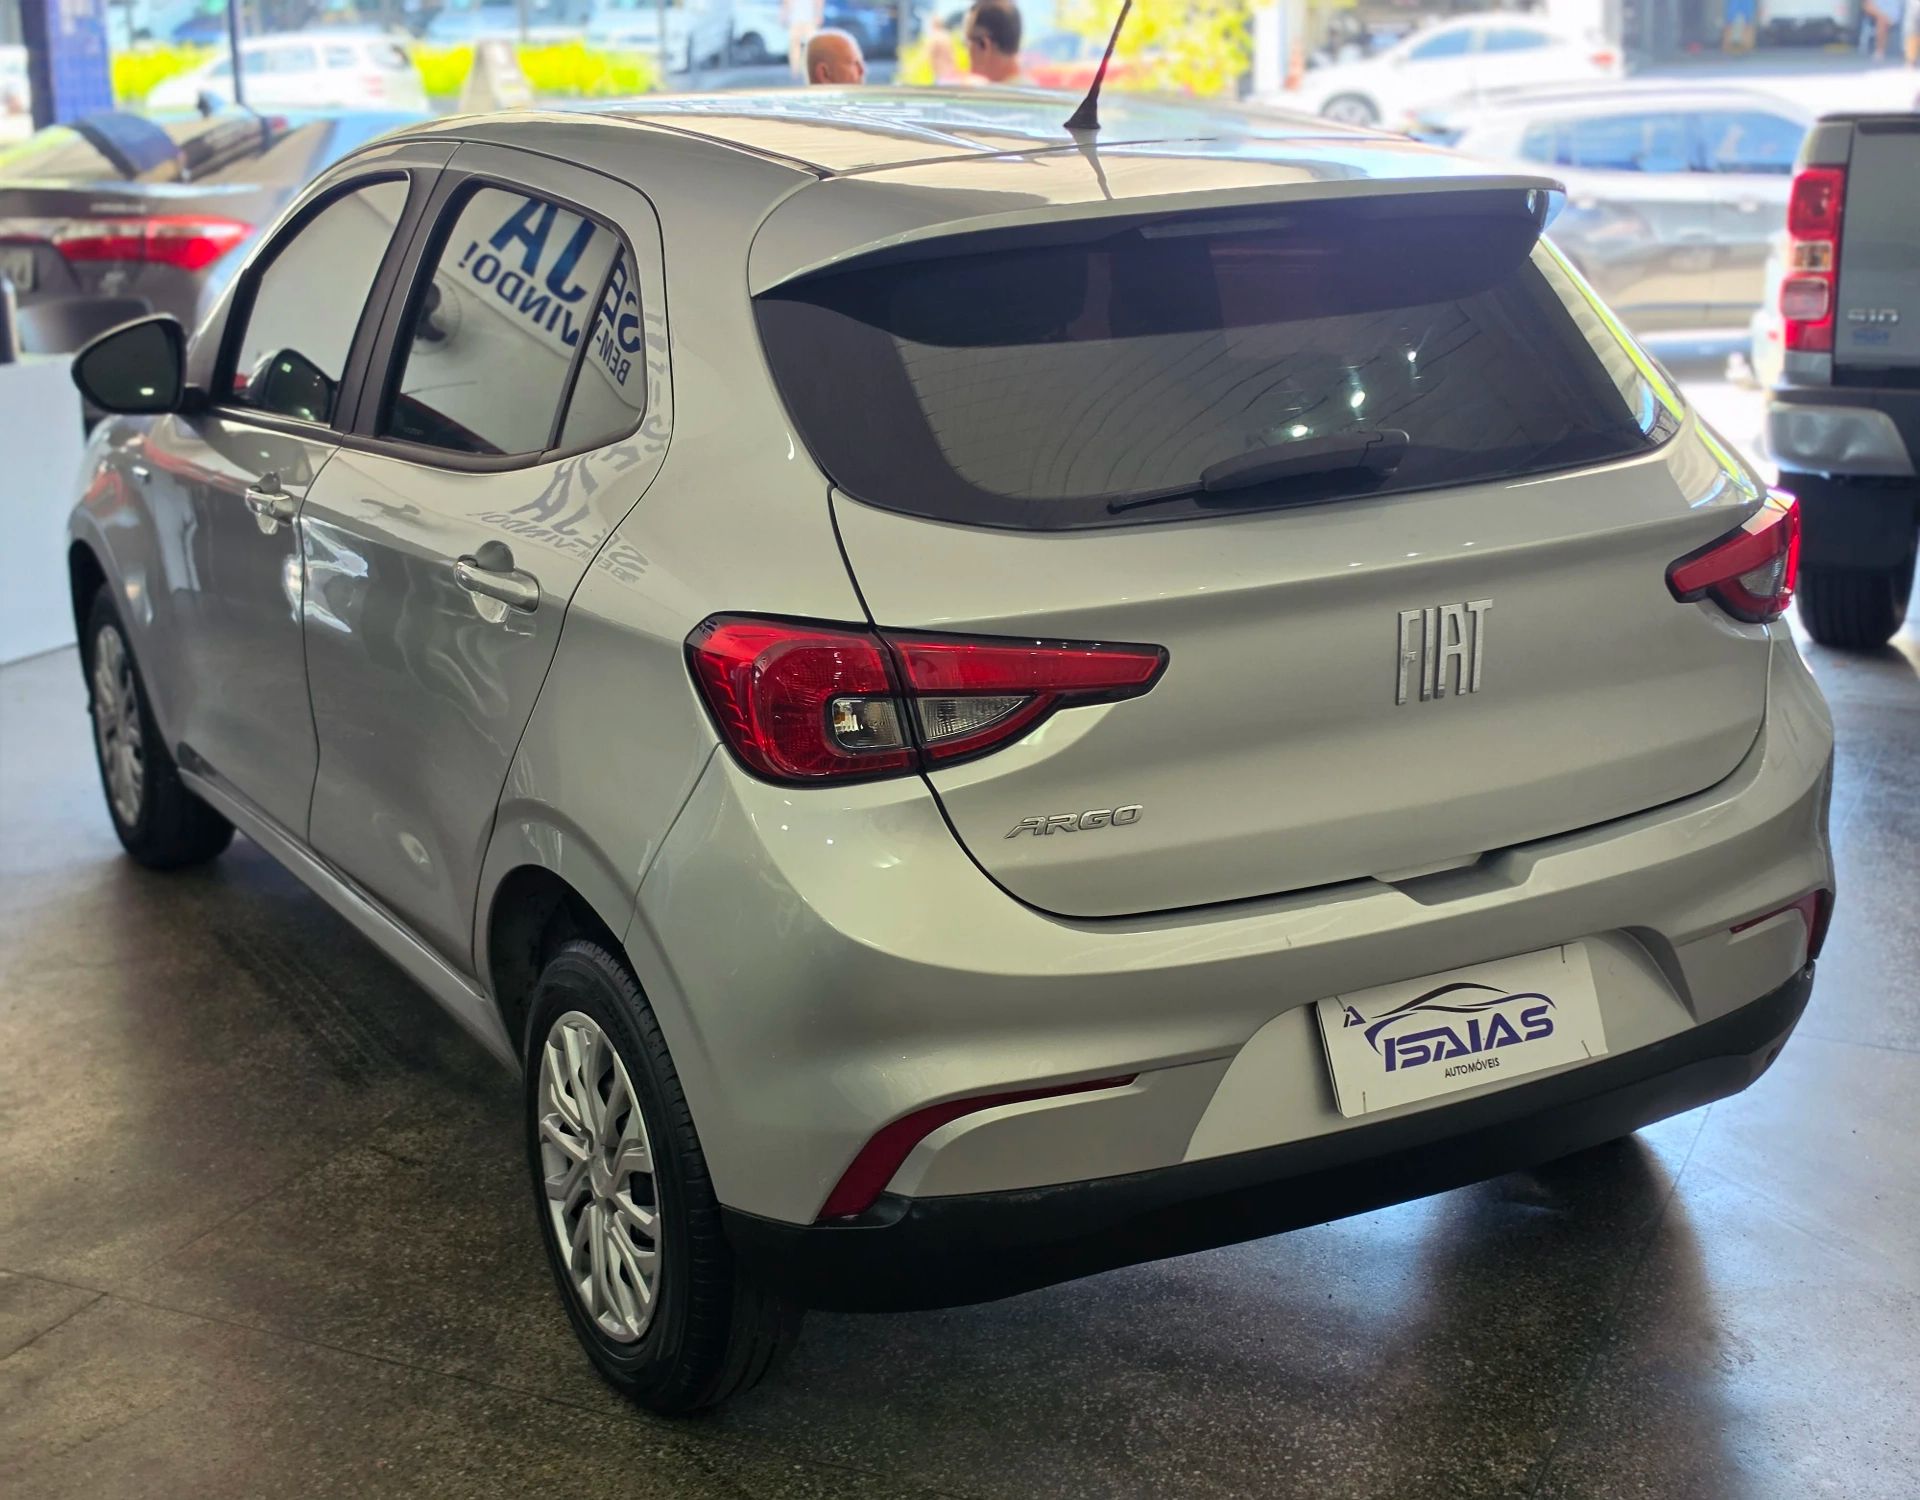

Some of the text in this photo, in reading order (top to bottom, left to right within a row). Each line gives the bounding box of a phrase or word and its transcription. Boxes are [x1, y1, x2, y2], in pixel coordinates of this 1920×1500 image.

[1395, 599, 1493, 706] FIAT
[1003, 804, 1144, 839] ARGO
[1383, 1004, 1555, 1073] ISAIAS
[1444, 1057, 1500, 1078] AUTOMÓVEIS
